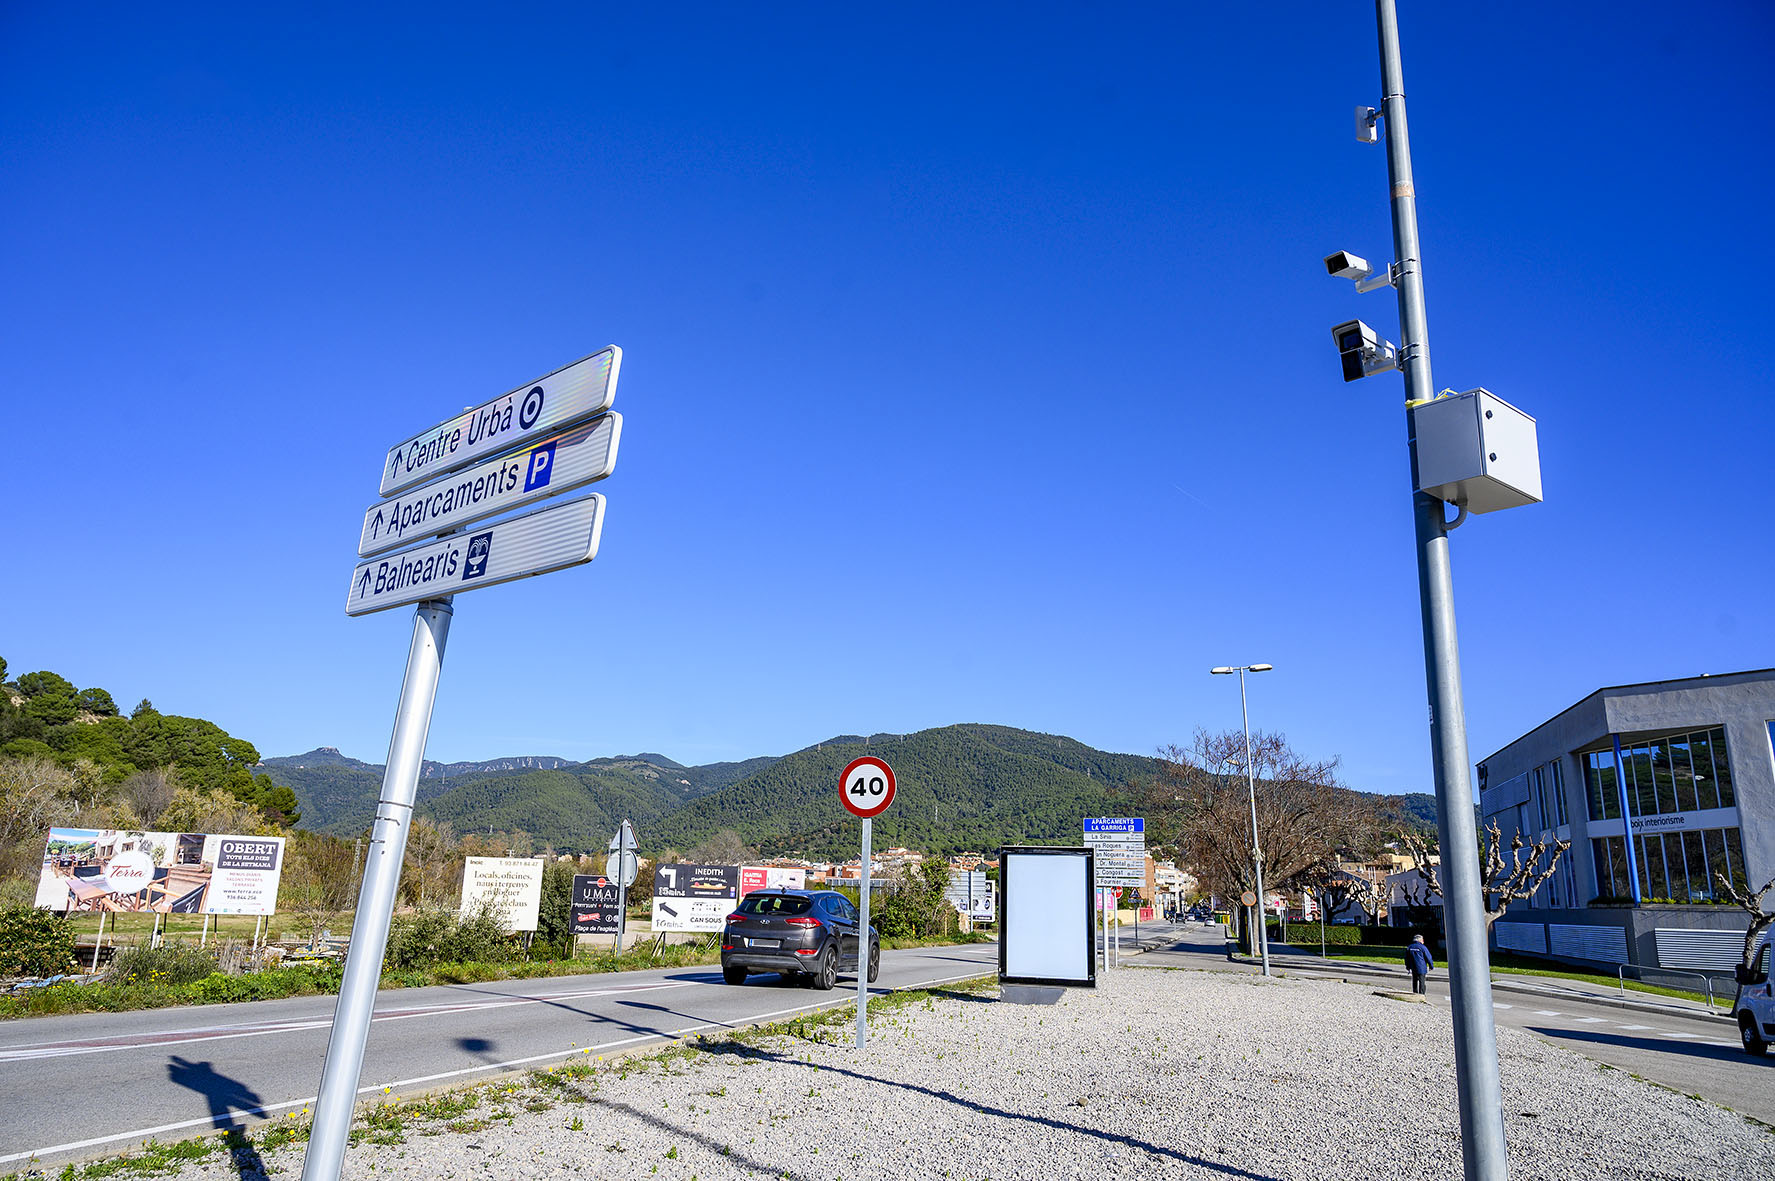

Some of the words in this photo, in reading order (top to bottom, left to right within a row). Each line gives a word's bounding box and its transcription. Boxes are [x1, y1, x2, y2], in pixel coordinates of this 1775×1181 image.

[406, 427, 461, 473] Centre
[467, 397, 513, 445] Urbà
[387, 460, 519, 537] Aparcaments
[529, 450, 549, 484] P
[374, 543, 459, 595] Balnearis
[850, 776, 884, 796] 40
[1644, 816, 1685, 827] interiorisme
[222, 842, 276, 855] OBERT
[109, 865, 145, 878] Terra
[474, 870, 500, 879] Locals,
[500, 871, 532, 880] oficines,
[695, 868, 724, 876] INEDITH
